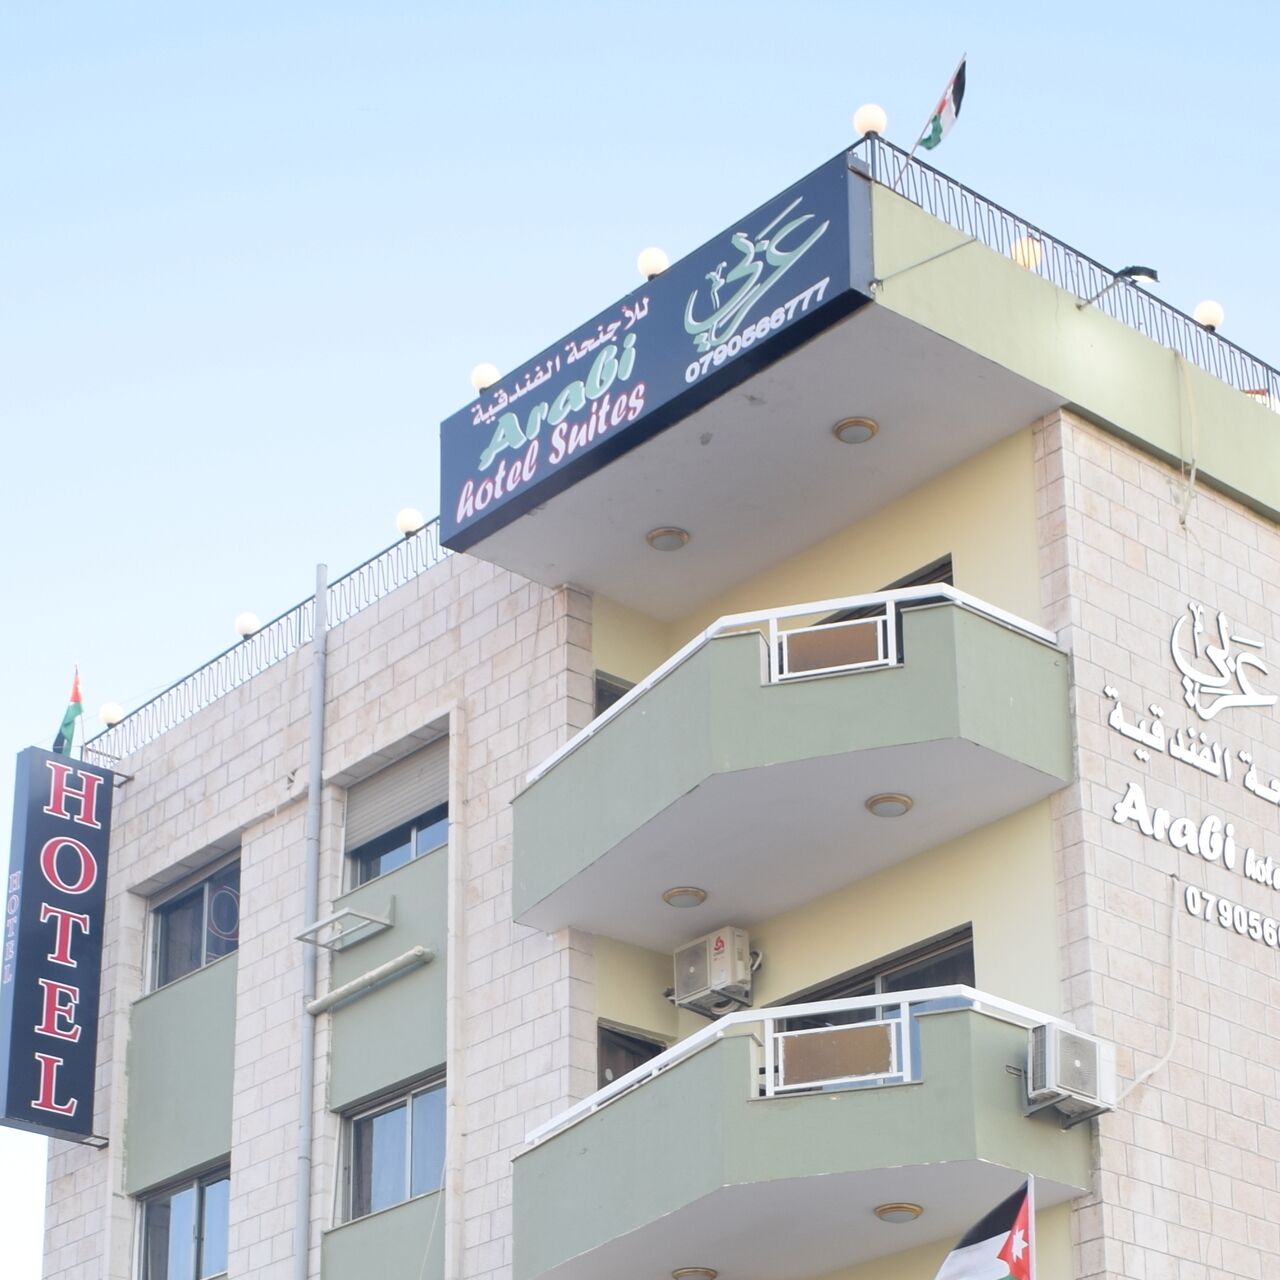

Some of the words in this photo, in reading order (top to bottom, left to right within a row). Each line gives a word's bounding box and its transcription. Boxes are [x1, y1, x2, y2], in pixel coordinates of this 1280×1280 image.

[685, 276, 830, 384] 0790566777
[472, 354, 561, 426] الفندقية
[478, 332, 637, 472] Arabi
[456, 440, 539, 524] hotel
[548, 383, 646, 465] Suites
[1103, 684, 1233, 782] الفندقية
[1113, 782, 1237, 870] Arabi
[31, 760, 105, 1118] HOTEL
